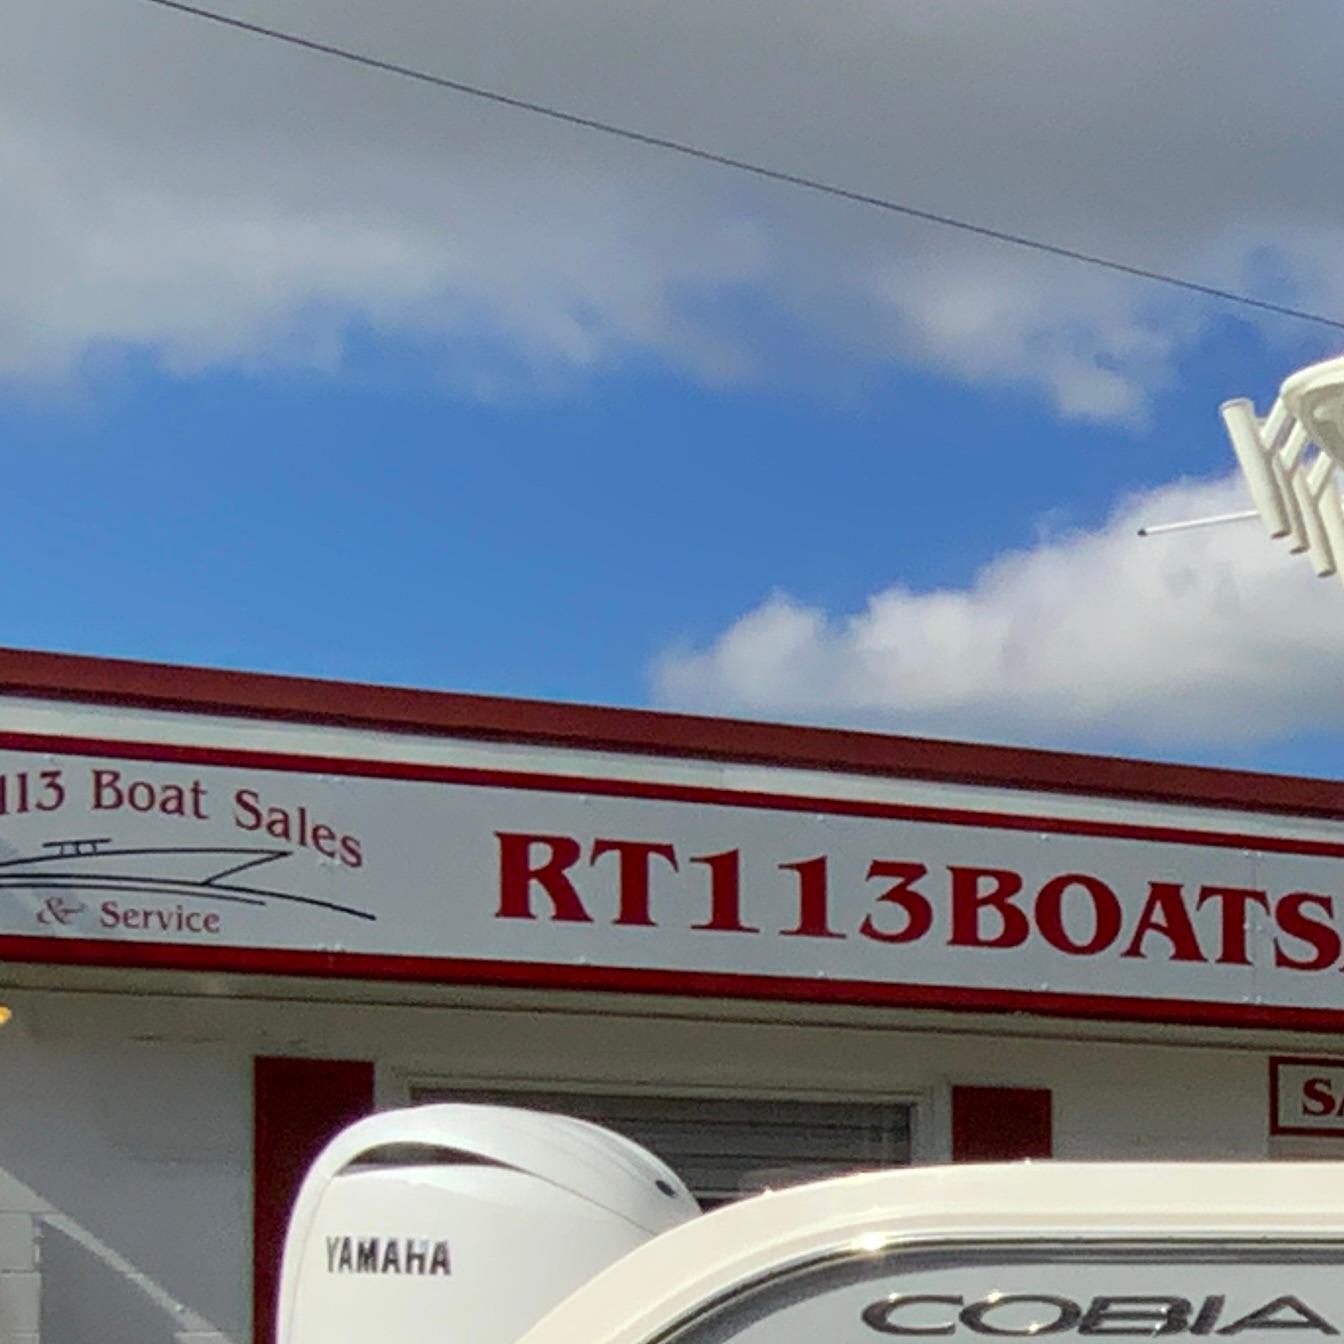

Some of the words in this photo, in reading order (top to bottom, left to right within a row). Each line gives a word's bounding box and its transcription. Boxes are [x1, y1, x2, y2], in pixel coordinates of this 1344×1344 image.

[91, 769, 208, 820] Boat
[233, 788, 363, 868] Sales
[37, 898, 85, 925] &
[100, 900, 220, 933] Service
[326, 1236, 452, 1275] YAMAHA
[861, 1294, 1340, 1337] COBIA
